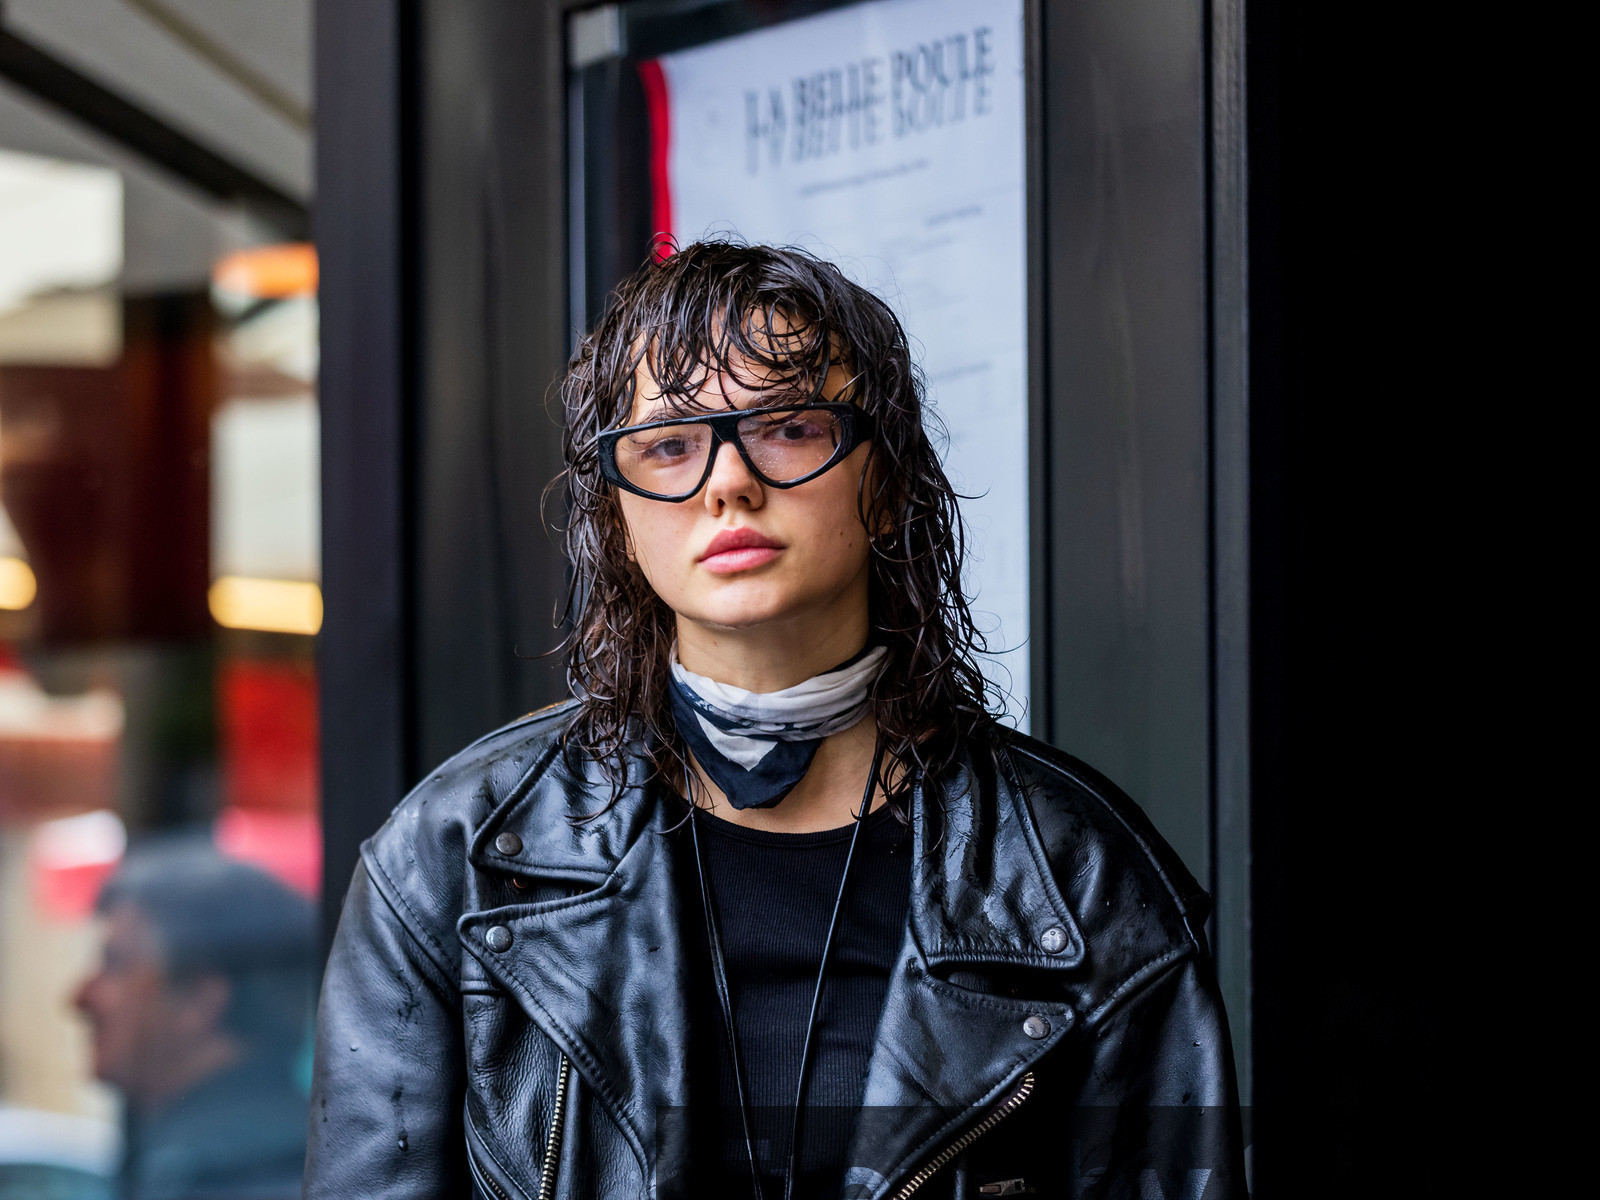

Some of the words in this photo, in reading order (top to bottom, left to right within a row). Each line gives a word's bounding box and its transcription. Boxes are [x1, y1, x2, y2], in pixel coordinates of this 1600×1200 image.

[743, 86, 787, 138] LA
[790, 58, 887, 122] BELLE
[889, 26, 995, 98] POULE
